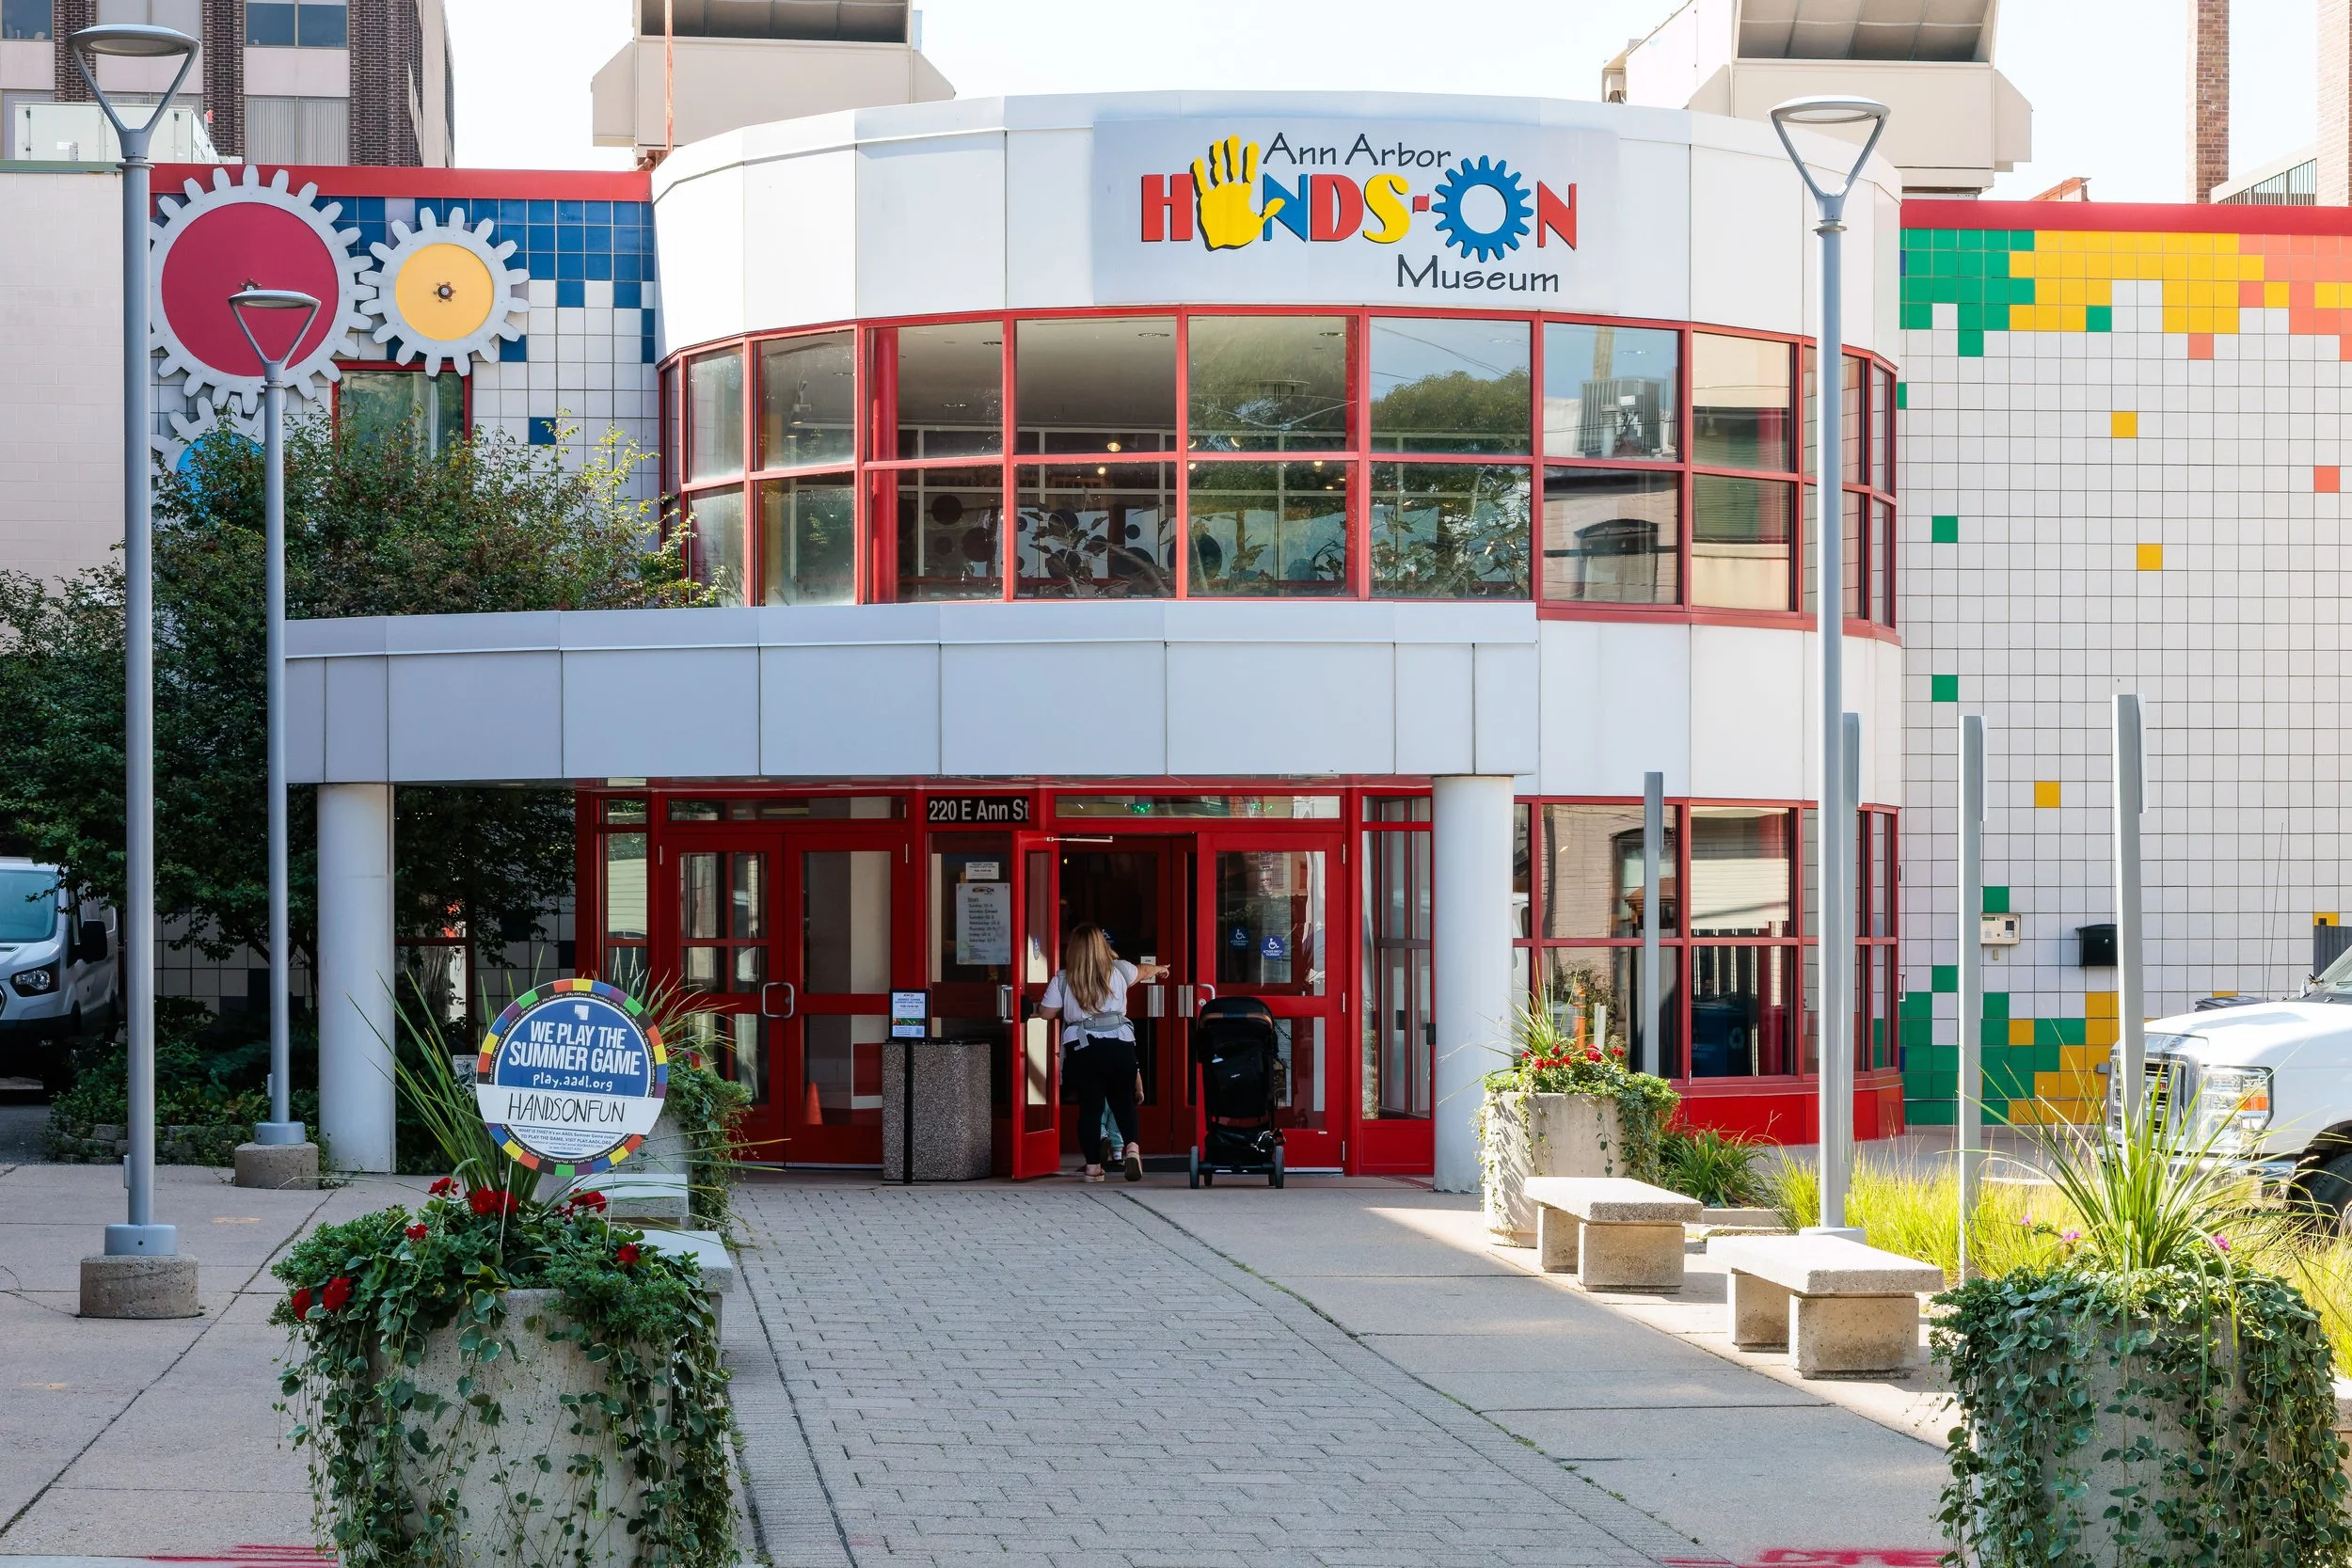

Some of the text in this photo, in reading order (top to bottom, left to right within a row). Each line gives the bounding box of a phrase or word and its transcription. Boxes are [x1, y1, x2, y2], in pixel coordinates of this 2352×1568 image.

[1263, 132, 1452, 168] Ann Arbor
[1397, 253, 1560, 293] Museum
[929, 799, 1030, 821] 220 E Ann St
[531, 1021, 628, 1049] WE PLAY THE
[508, 1041, 588, 1071] SUMMER
[591, 1048, 642, 1075] GAME
[532, 1071, 613, 1091] play.aadl.org
[507, 1092, 626, 1123] HANDSONFUN
